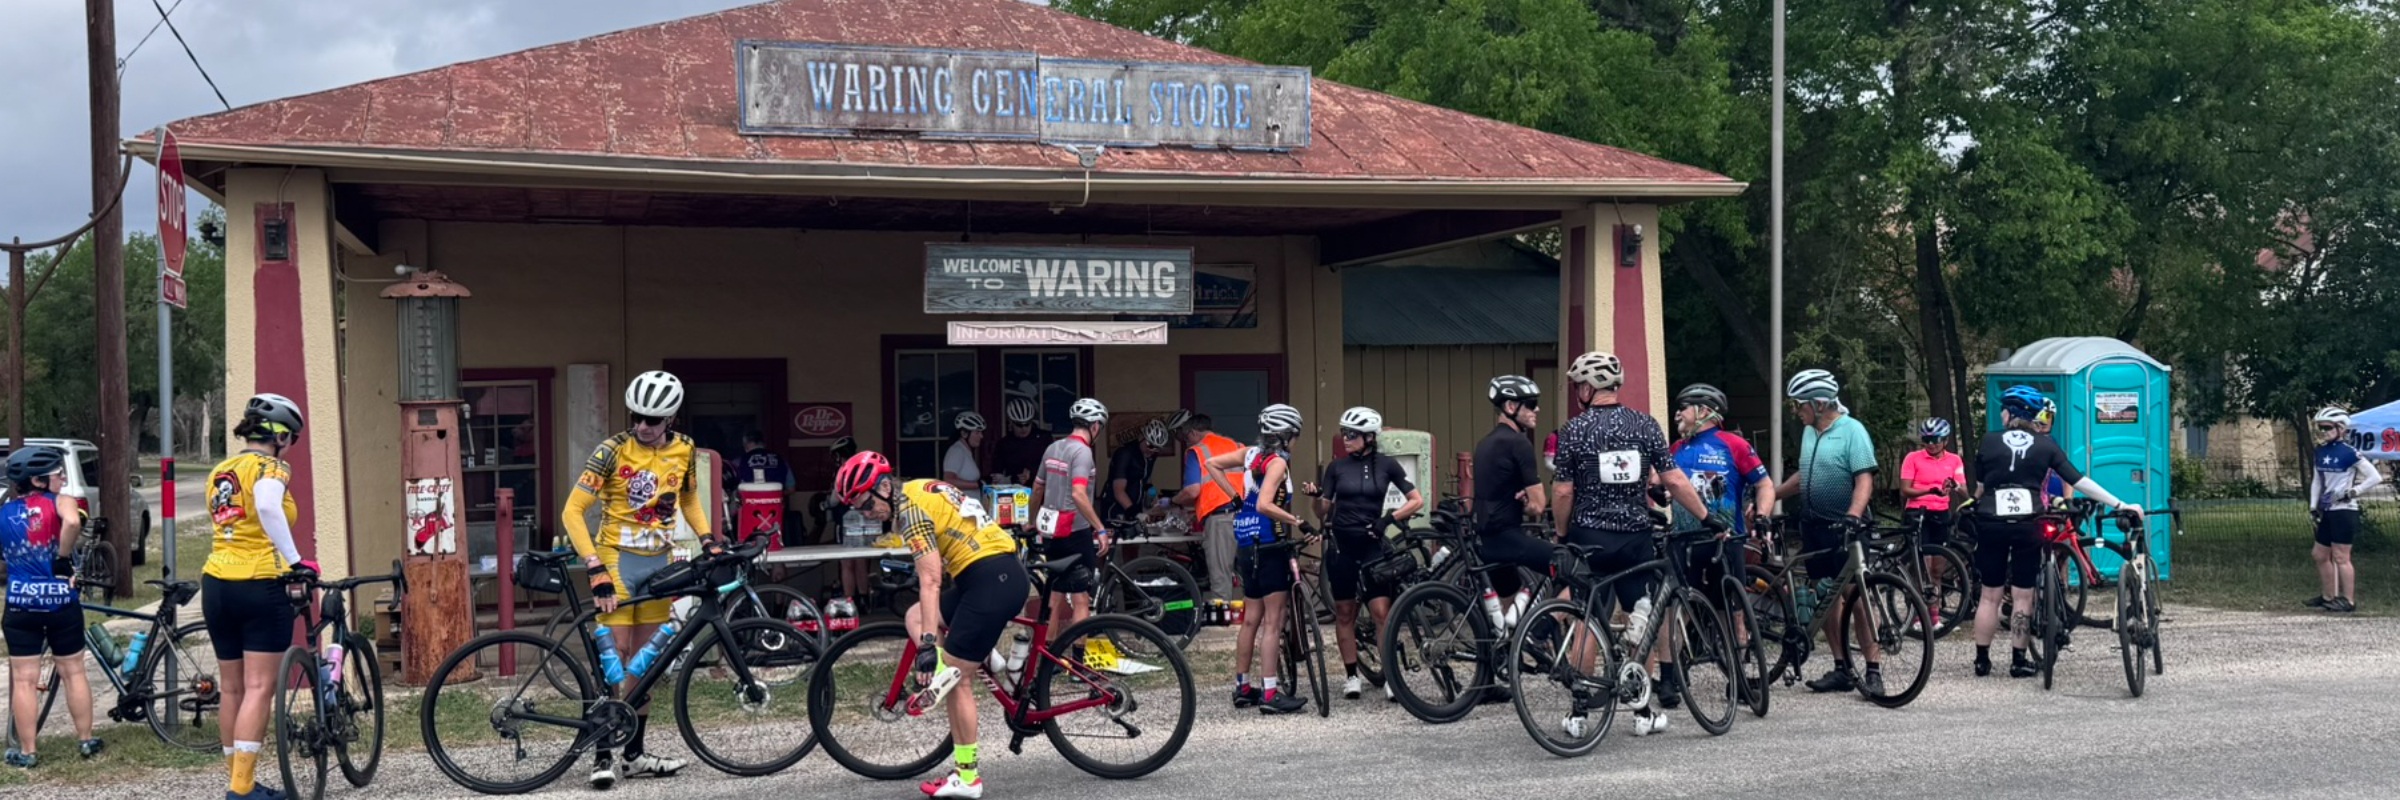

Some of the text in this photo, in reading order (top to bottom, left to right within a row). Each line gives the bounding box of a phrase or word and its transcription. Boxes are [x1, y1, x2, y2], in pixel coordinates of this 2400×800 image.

[806, 60, 1251, 130] WARING GENERAL STORE
[160, 169, 184, 232] STOP
[943, 258, 1022, 274] WELCOME
[966, 278, 1004, 290] TO
[1023, 258, 1176, 299] WARING
[815, 408, 834, 420] Dr
[801, 414, 842, 432] Pepper
[1613, 472, 1630, 481] 135
[2007, 505, 2020, 513] 70
[10, 580, 70, 596] EASTER
[8, 595, 71, 606] BIKE TOUR
